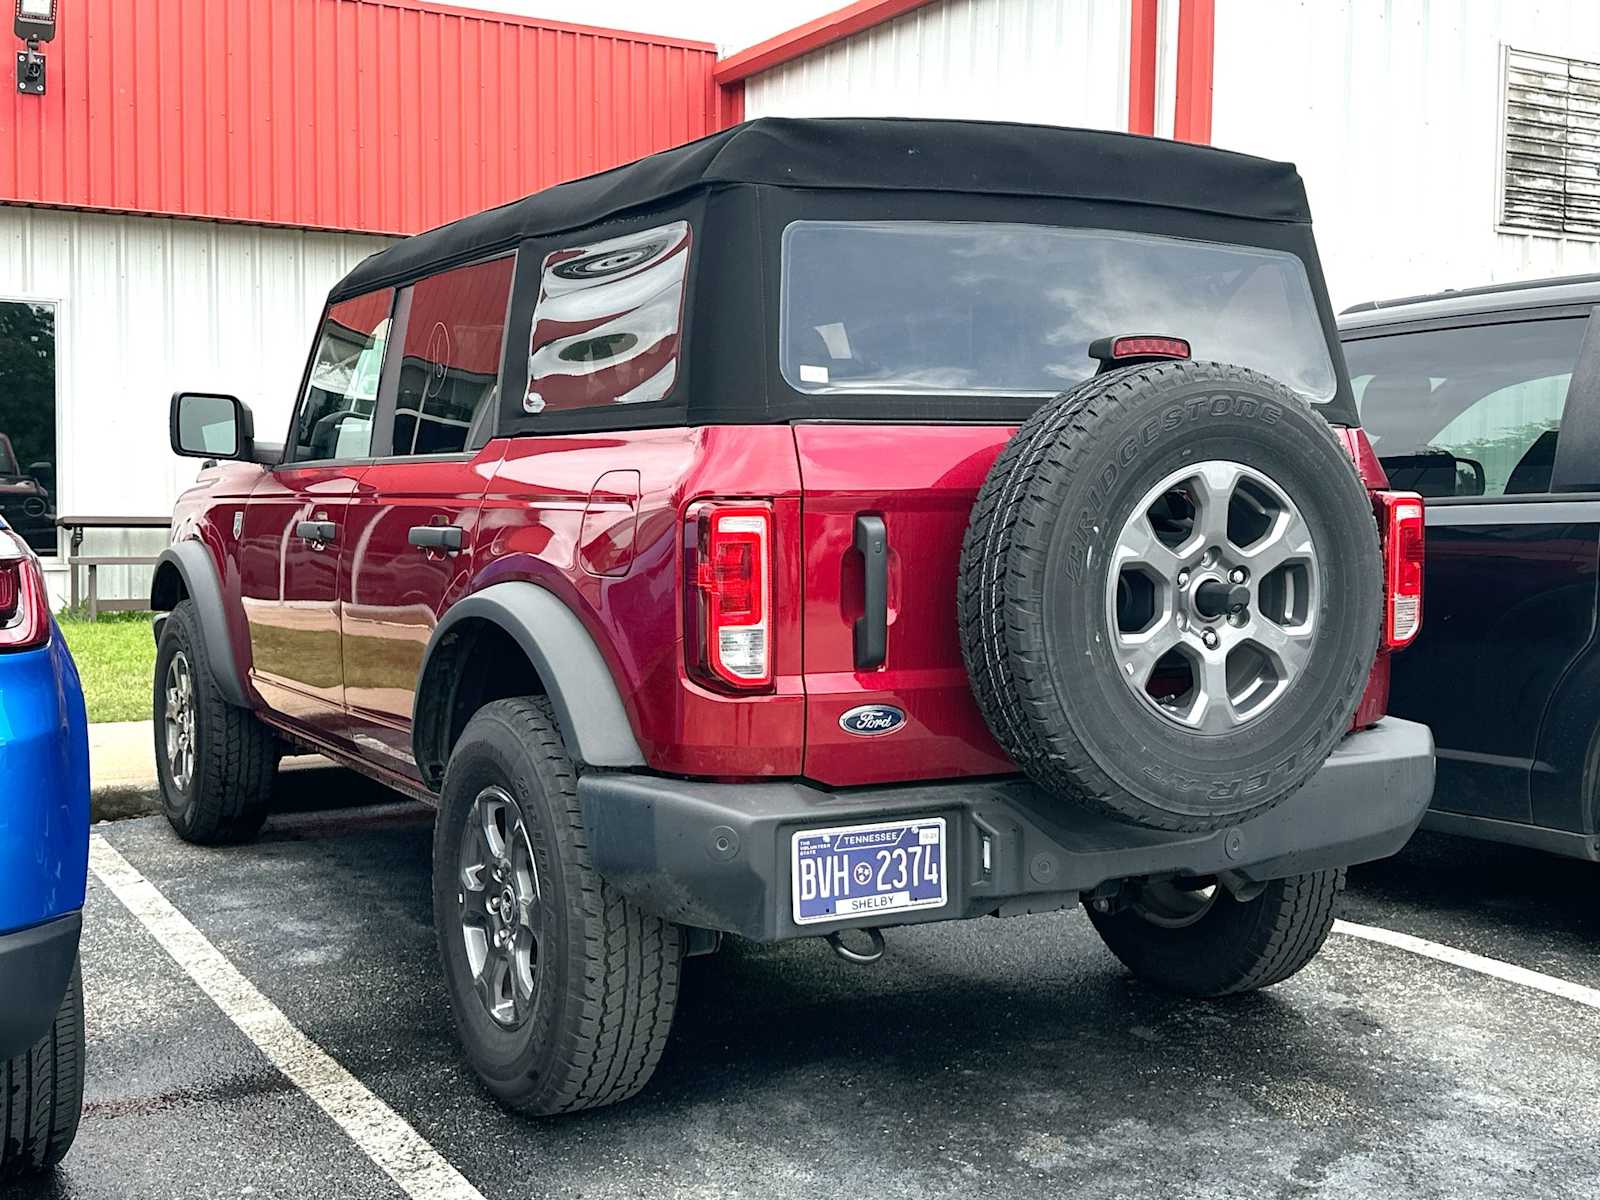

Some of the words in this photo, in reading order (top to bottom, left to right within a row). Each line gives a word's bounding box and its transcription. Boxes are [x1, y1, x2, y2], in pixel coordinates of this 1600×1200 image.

[1063, 394, 1283, 587] BRIDGESTONE
[857, 712, 892, 729] Ford
[844, 832, 898, 845] TENNESSEE
[800, 854, 850, 901] BVH
[876, 845, 939, 892] 2374
[852, 896, 895, 911] SHELBY
